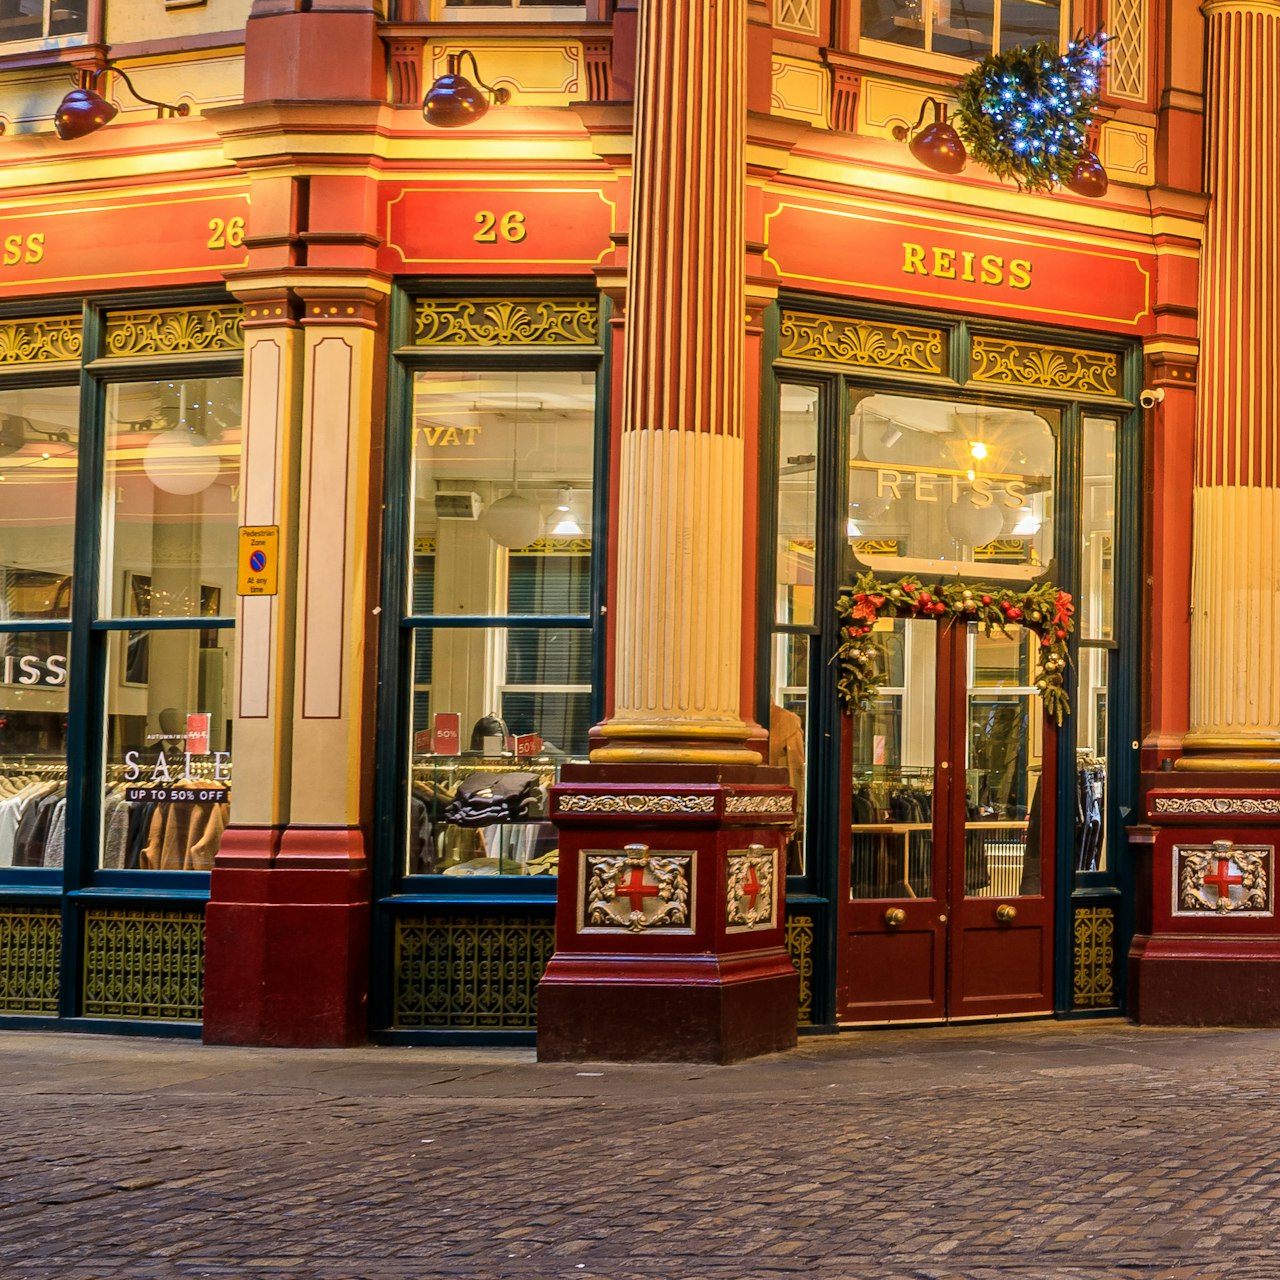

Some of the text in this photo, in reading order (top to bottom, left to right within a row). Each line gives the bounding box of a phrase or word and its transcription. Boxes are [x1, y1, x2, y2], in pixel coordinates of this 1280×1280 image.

[207, 216, 246, 249] 26
[473, 210, 527, 244] 26
[902, 242, 1033, 290] REISS
[877, 469, 1026, 509] REISS
[437, 730, 457, 738] 50%
[518, 741, 537, 753] 50%
[124, 750, 231, 782] SALE
[130, 791, 223, 800] UP TO 50% OFF
